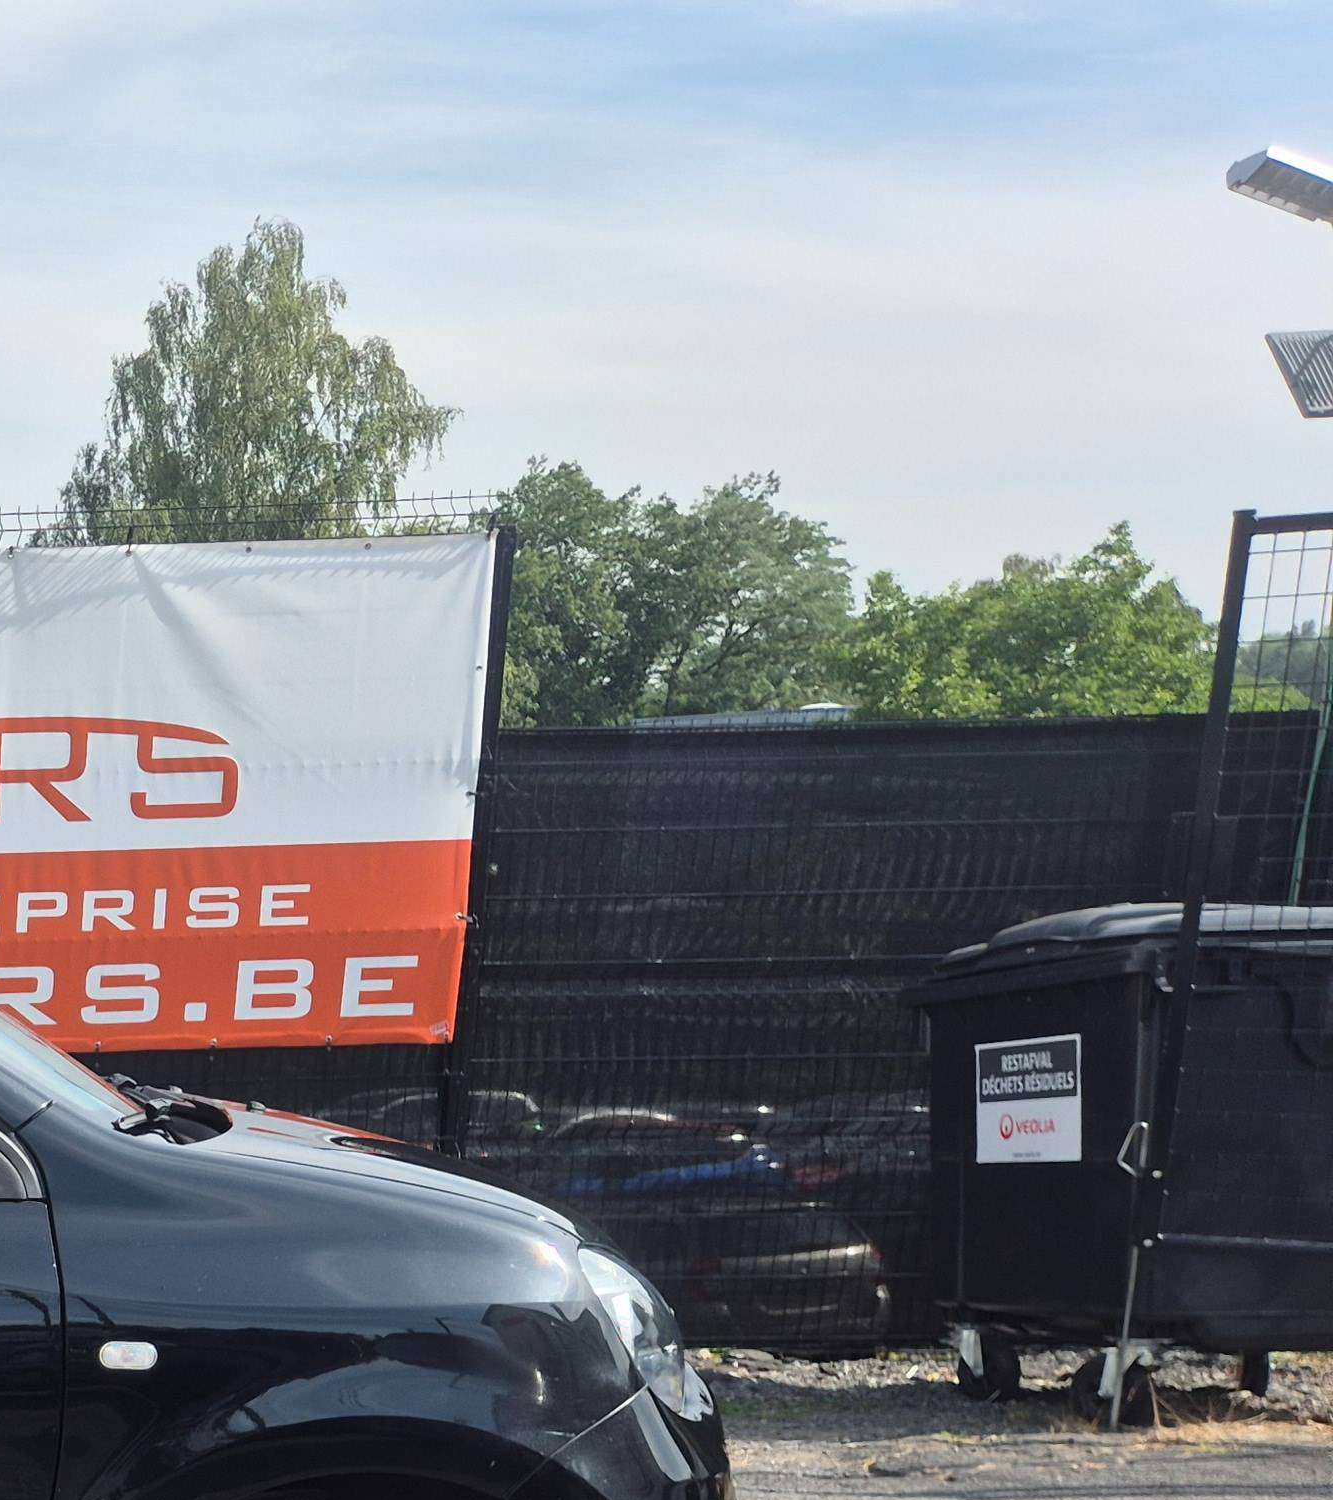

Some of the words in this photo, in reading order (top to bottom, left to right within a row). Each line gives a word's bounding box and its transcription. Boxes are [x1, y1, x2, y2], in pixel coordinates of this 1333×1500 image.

[1001, 1051, 1053, 1073] RESTAFVAL
[982, 1074, 1023, 1096] DÉCHETS
[1014, 1119, 1055, 1134] VEOLIA
